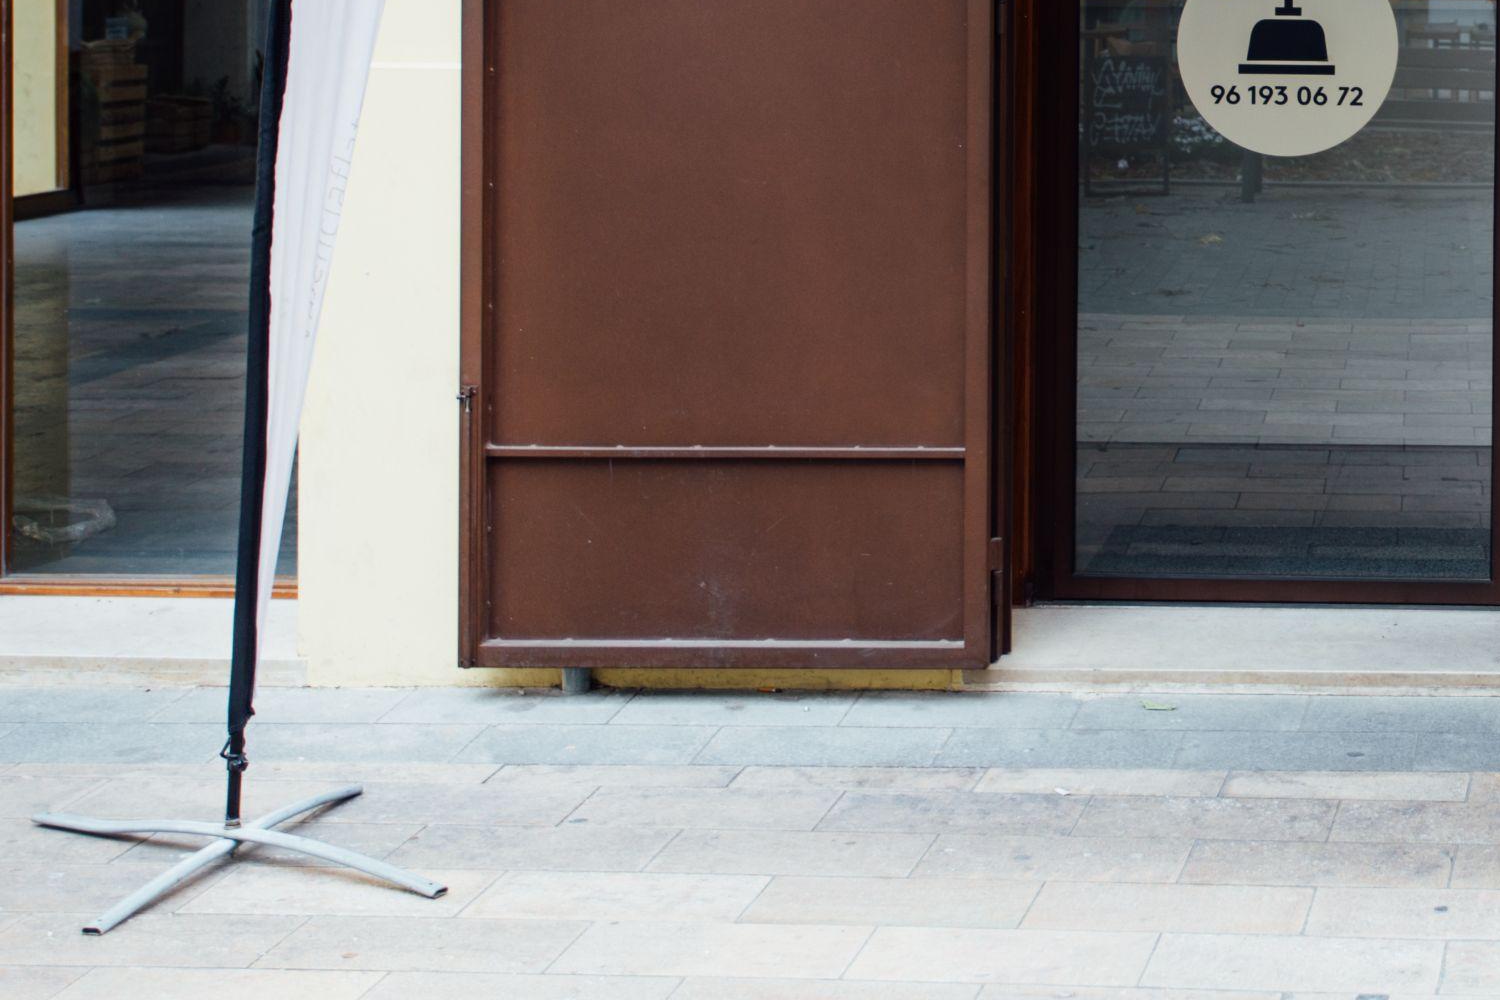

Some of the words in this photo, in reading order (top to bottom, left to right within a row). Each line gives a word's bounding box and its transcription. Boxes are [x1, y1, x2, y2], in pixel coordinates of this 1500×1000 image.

[1210, 85, 1241, 105] 96
[1247, 85, 1289, 105] 193
[1297, 86, 1328, 106] 06
[1336, 86, 1363, 106] 72
